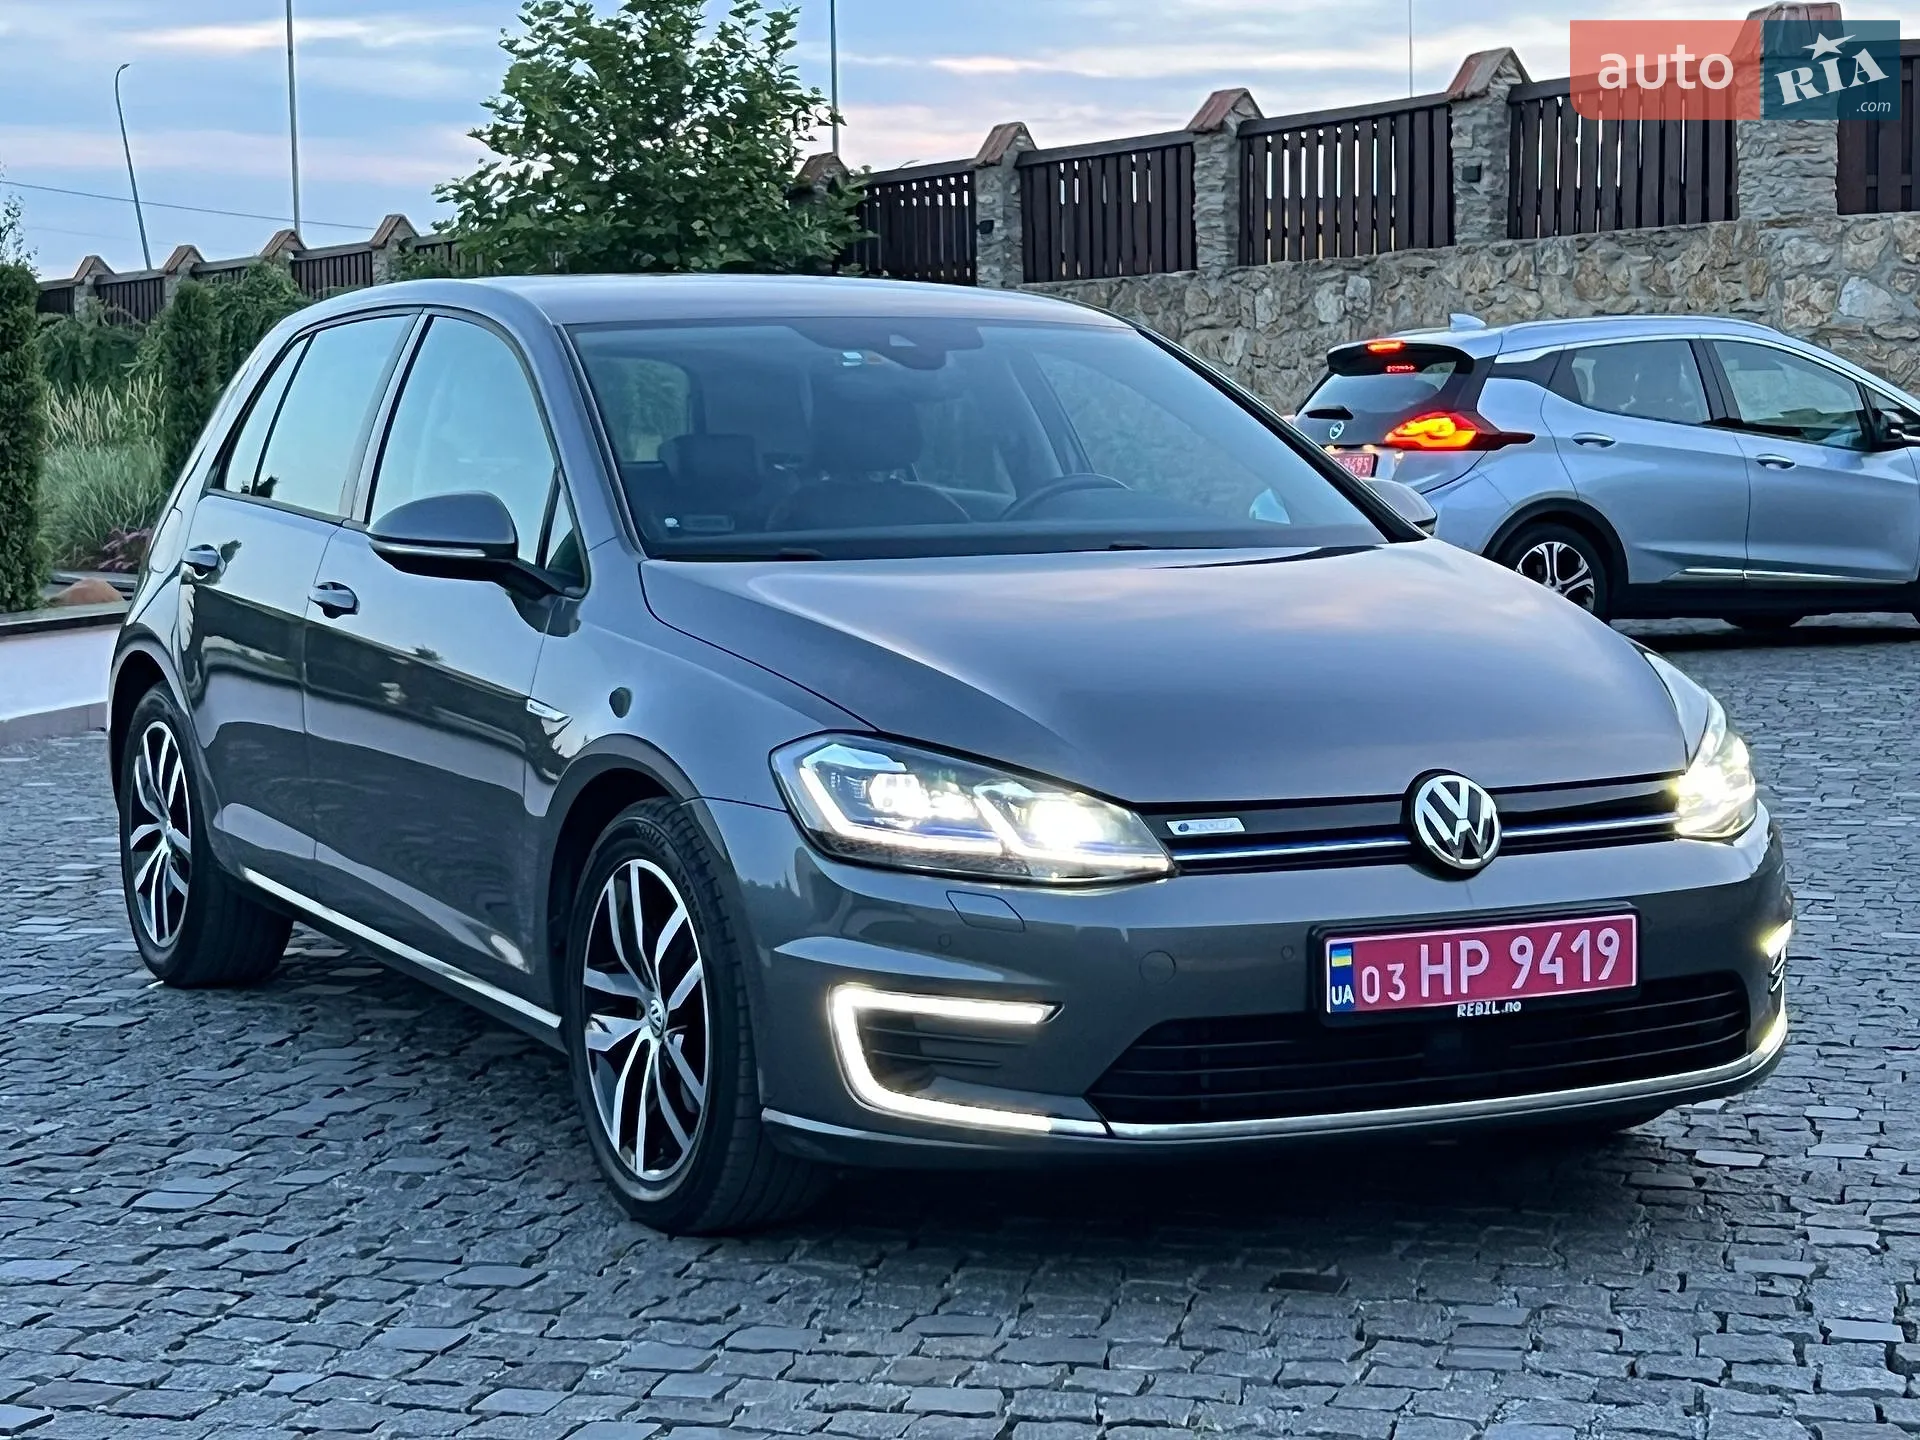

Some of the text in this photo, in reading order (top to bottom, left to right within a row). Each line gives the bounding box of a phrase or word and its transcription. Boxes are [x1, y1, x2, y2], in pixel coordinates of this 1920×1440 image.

[1331, 927, 1621, 1005] UA 03 HP 9419
